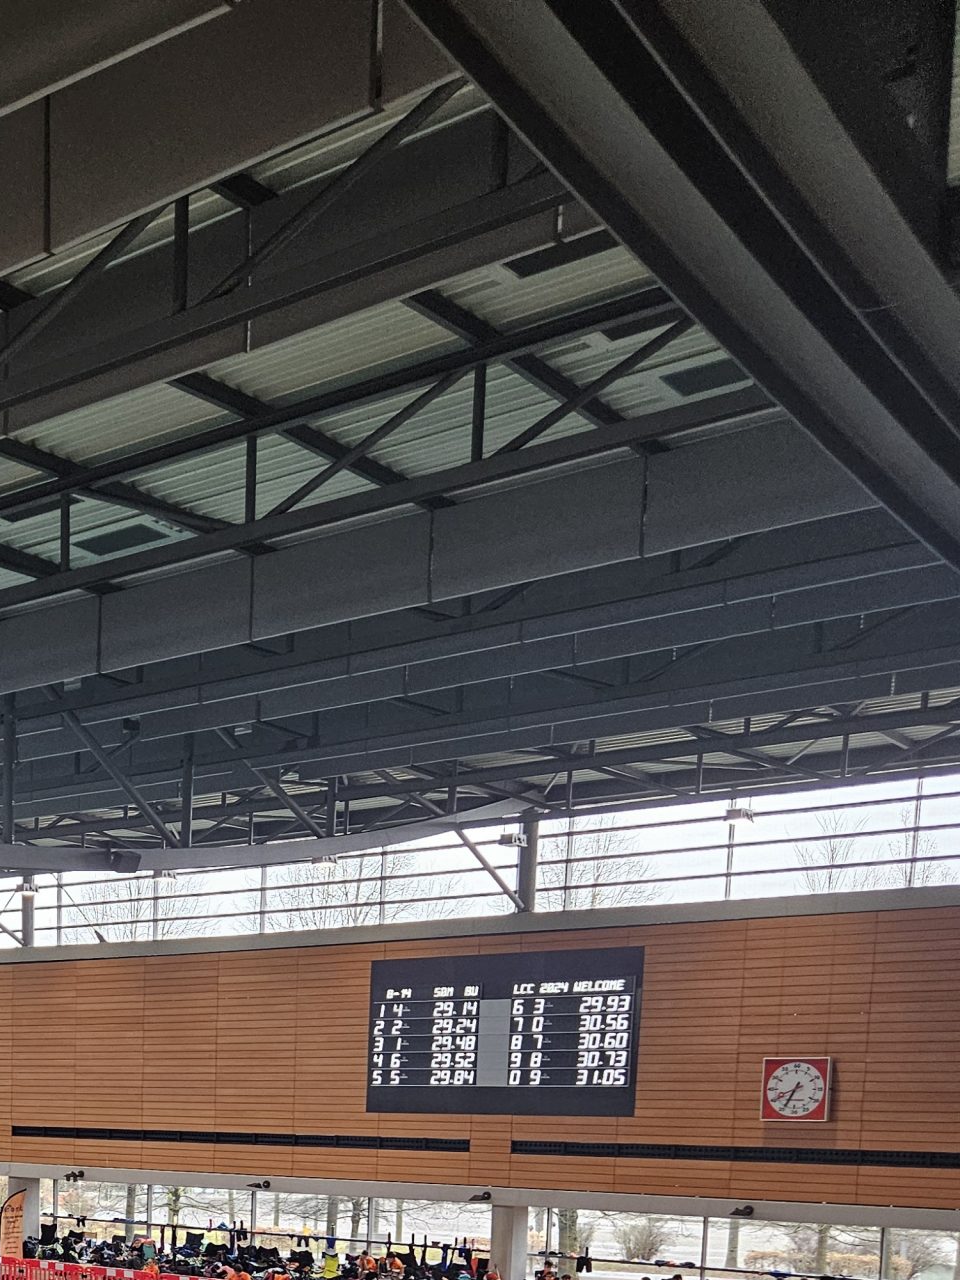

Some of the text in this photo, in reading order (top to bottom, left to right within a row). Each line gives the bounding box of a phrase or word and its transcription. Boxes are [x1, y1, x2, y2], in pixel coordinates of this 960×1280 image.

[433, 986, 454, 998] 50M
[512, 979, 626, 995] LCC 2024 WELCOME
[380, 1004, 385, 1017] 1
[393, 1004, 403, 1017] 4
[512, 995, 631, 1014] 6 3 29.93
[373, 1019, 477, 1034] 2 2 29.24
[513, 1014, 630, 1031] 7 0 30.56
[373, 1036, 476, 1051] 3 1 29.48
[511, 1032, 628, 1050] 8 7 30.60
[373, 1053, 475, 1068] 4 6 29.52
[510, 1051, 627, 1068] 9 8 30.73
[372, 1070, 474, 1084] 5 5 29.84
[509, 1069, 521, 1085] 0
[529, 1069, 541, 1085] 9
